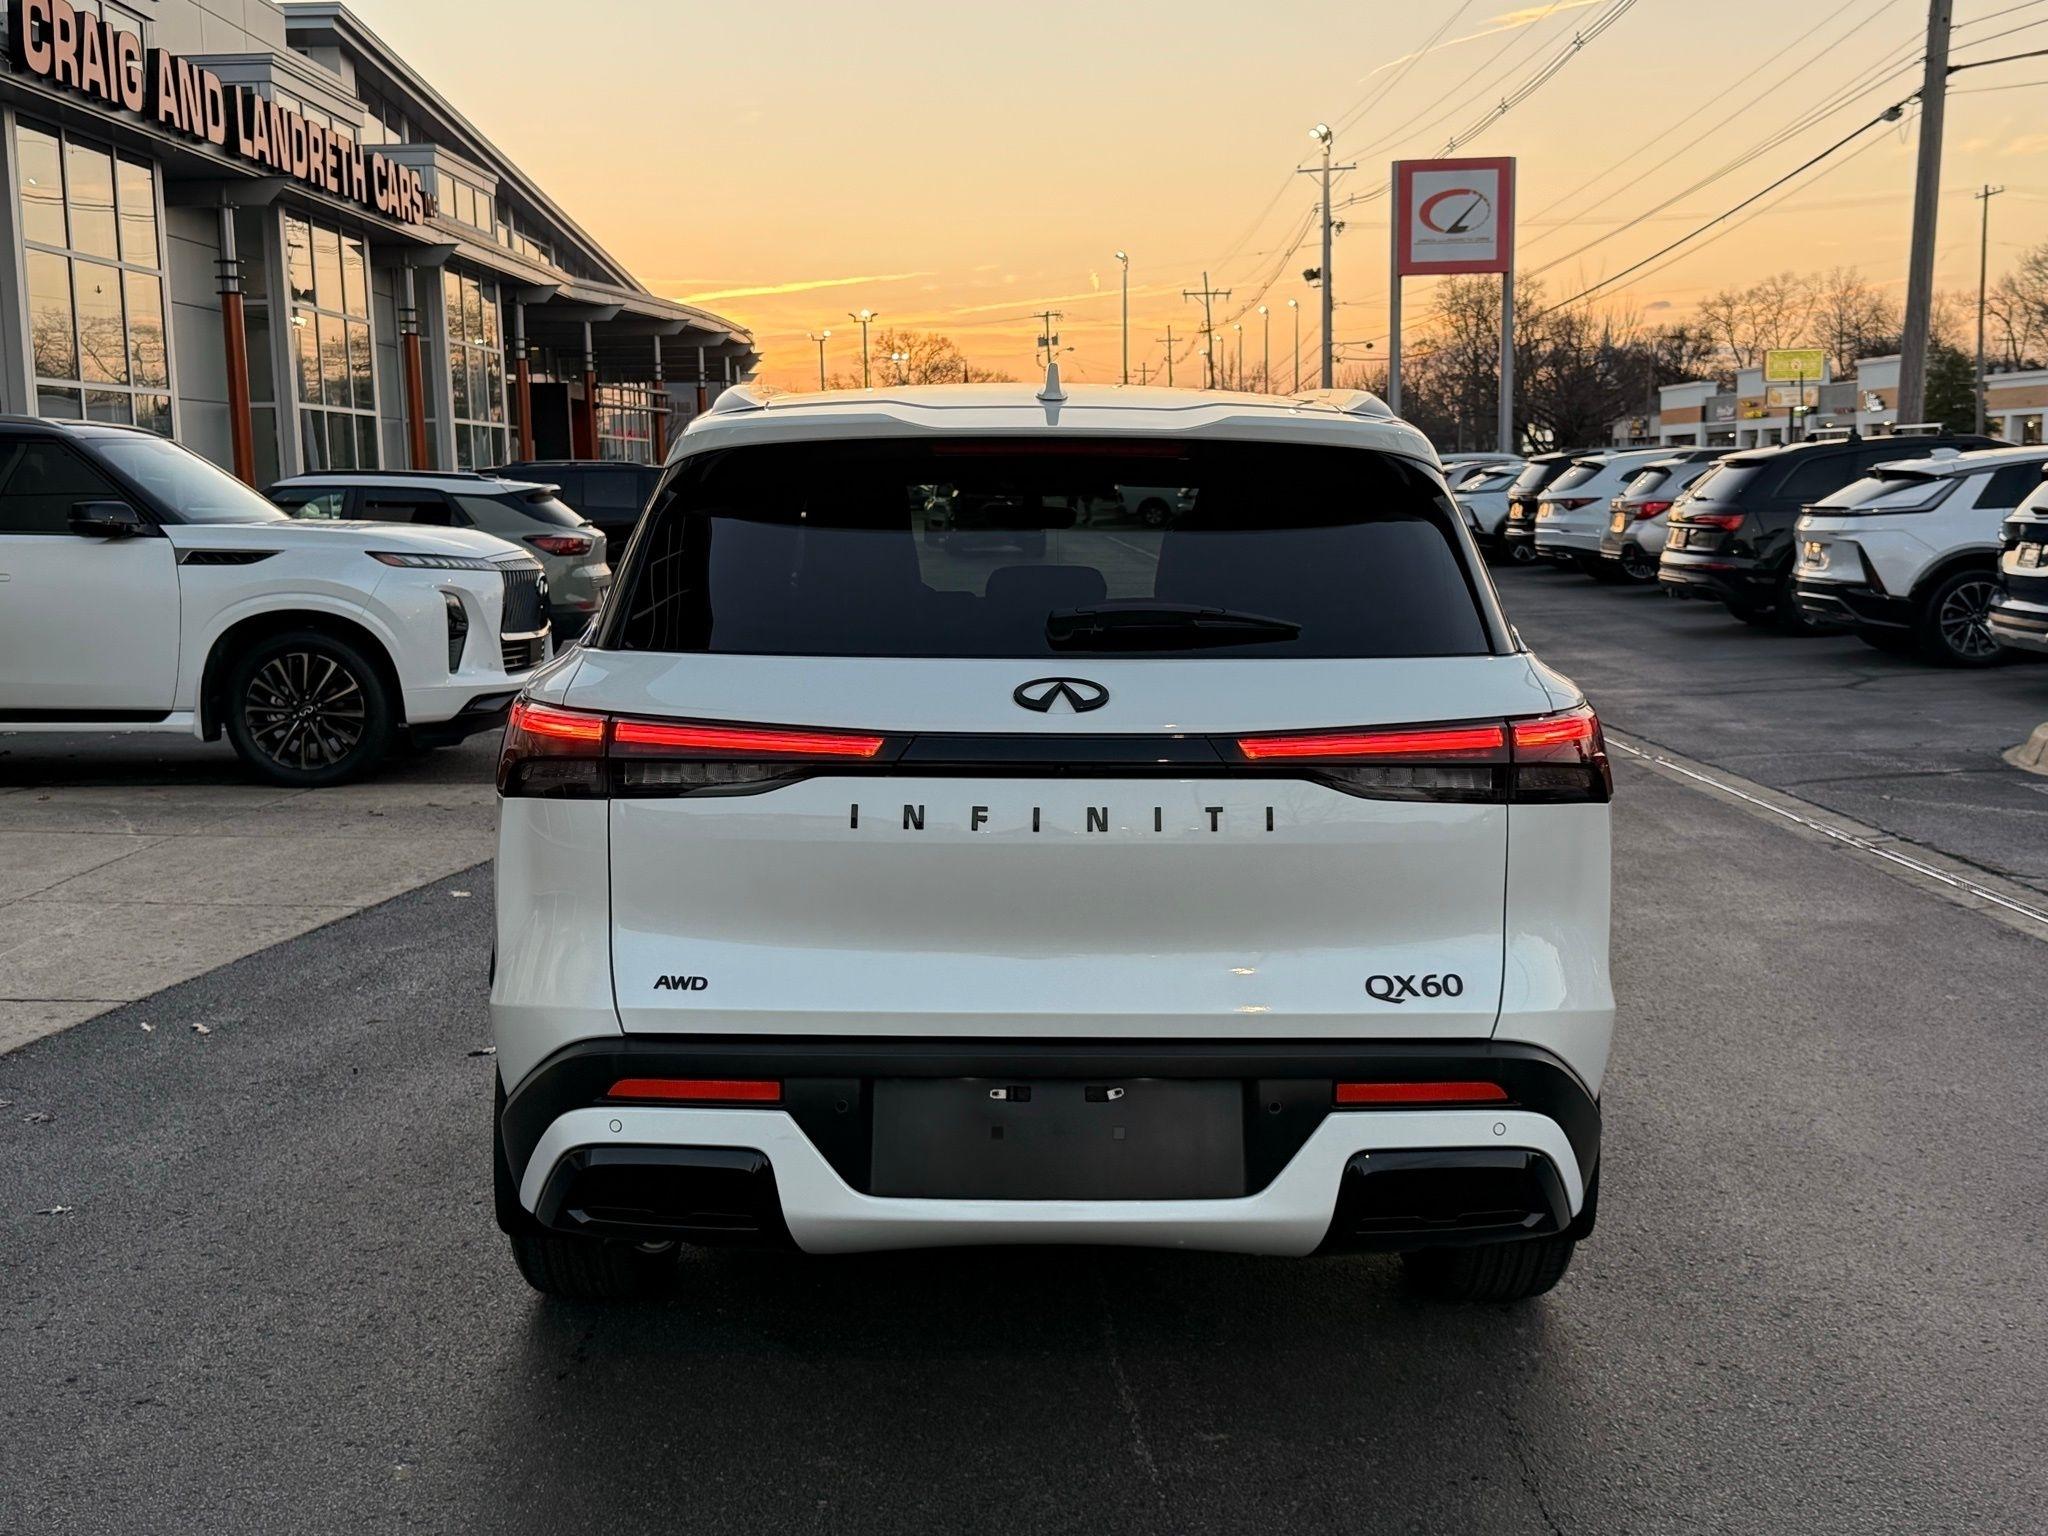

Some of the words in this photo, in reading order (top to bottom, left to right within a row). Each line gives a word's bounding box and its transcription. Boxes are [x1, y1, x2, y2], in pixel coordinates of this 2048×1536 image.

[22, 0, 143, 112] CRAIG
[158, 48, 226, 146] AND
[235, 85, 368, 204] LANDRETH
[372, 152, 424, 226] CARS
[849, 803, 1275, 832] INFINITI
[653, 975, 708, 991] AWD
[1365, 973, 1464, 1004] QX60
